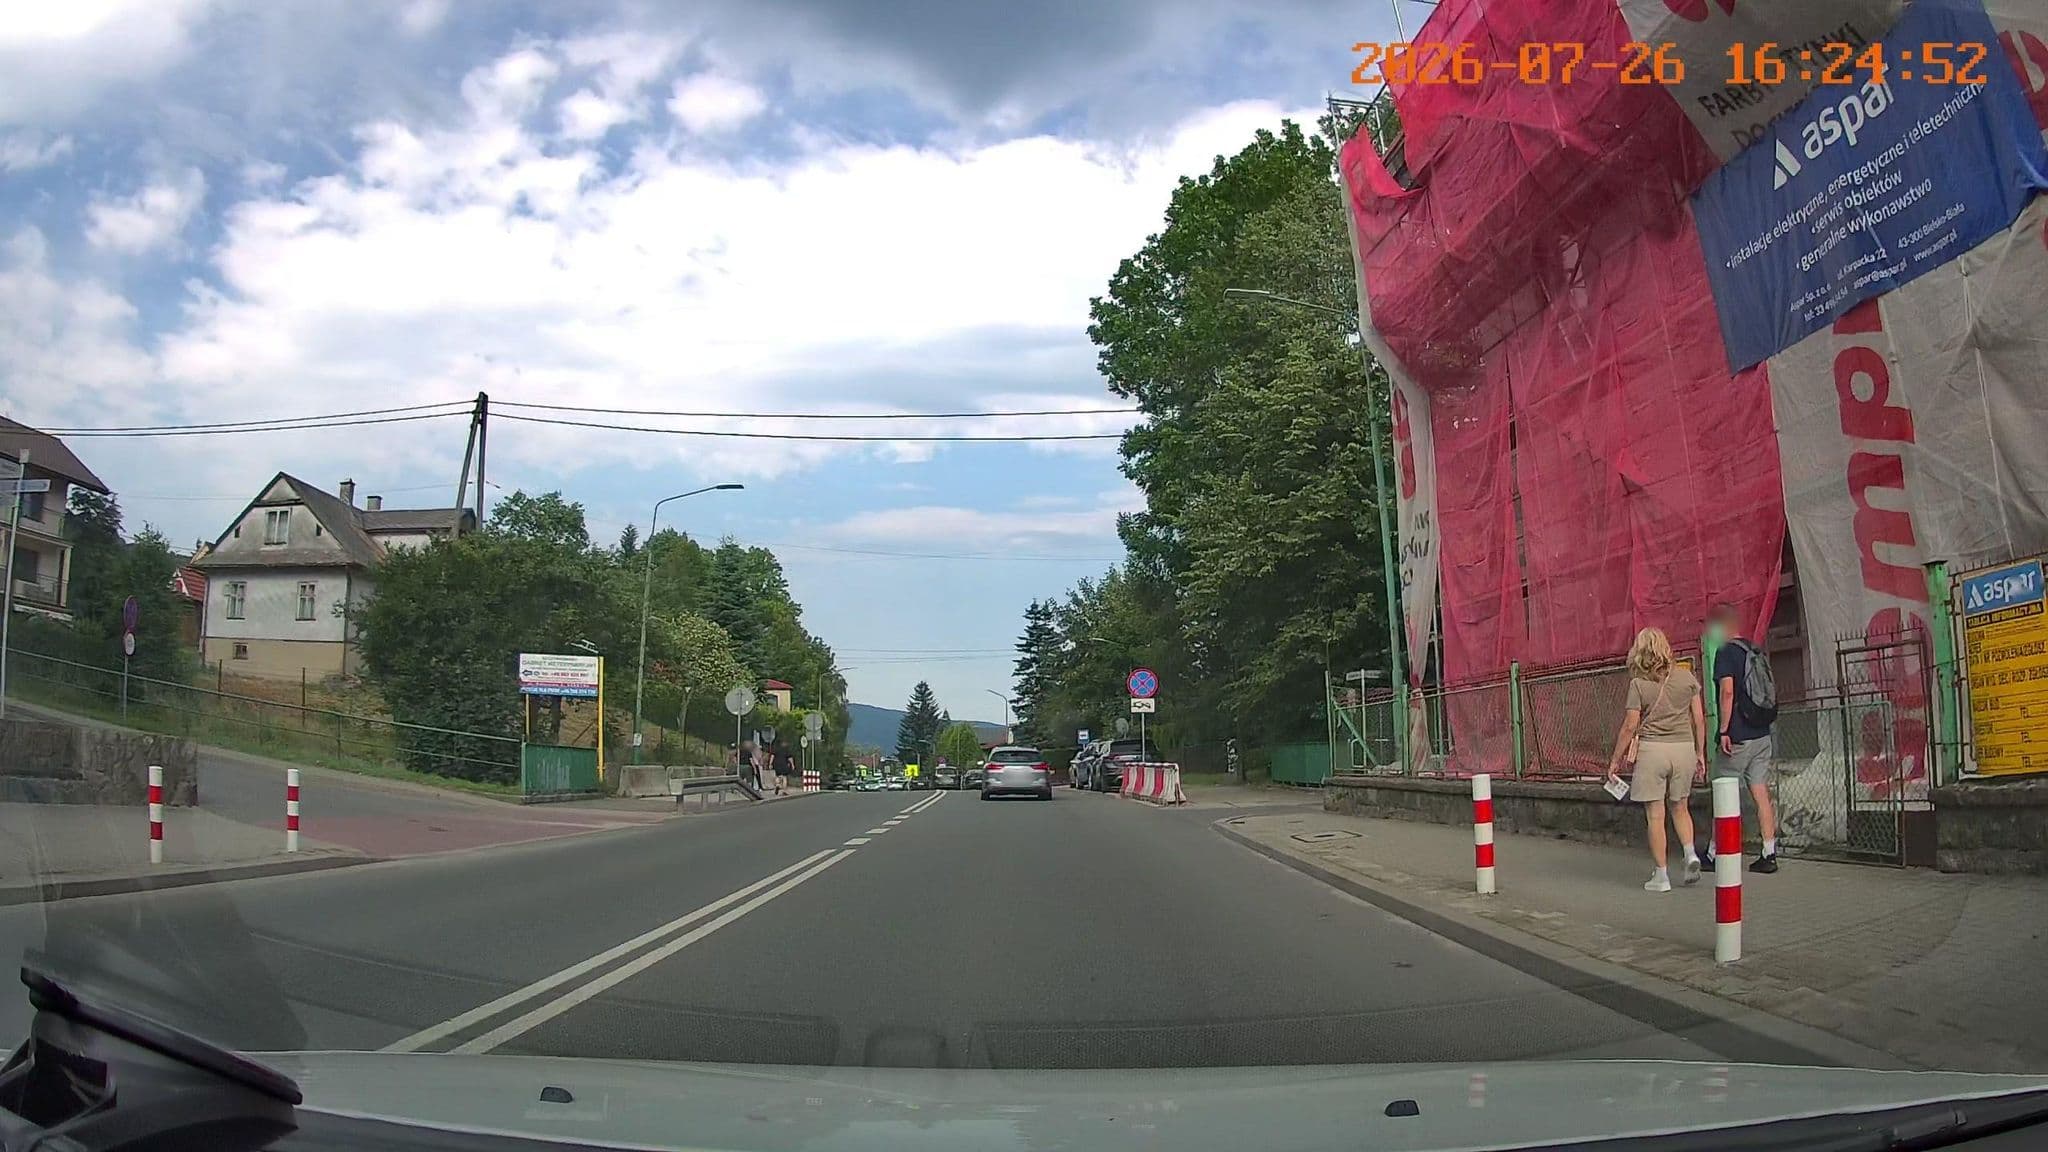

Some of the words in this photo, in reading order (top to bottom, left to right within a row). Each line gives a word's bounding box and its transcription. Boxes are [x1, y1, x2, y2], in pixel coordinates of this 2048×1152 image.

[1801, 62, 1895, 160] aspar
[1730, 232, 1772, 269] instalacje
[1773, 191, 1828, 238] elektryczne,
[1827, 142, 1905, 196] energetyczne
[1902, 134, 1910, 149] i
[1909, 83, 1985, 144] teletechniczn
[1815, 201, 1843, 234] serwis
[1843, 168, 1902, 209] obiektów
[1800, 226, 1847, 272] generalne
[1847, 178, 1932, 235] wykonawstwo
[1897, 228, 1923, 249] 43-300
